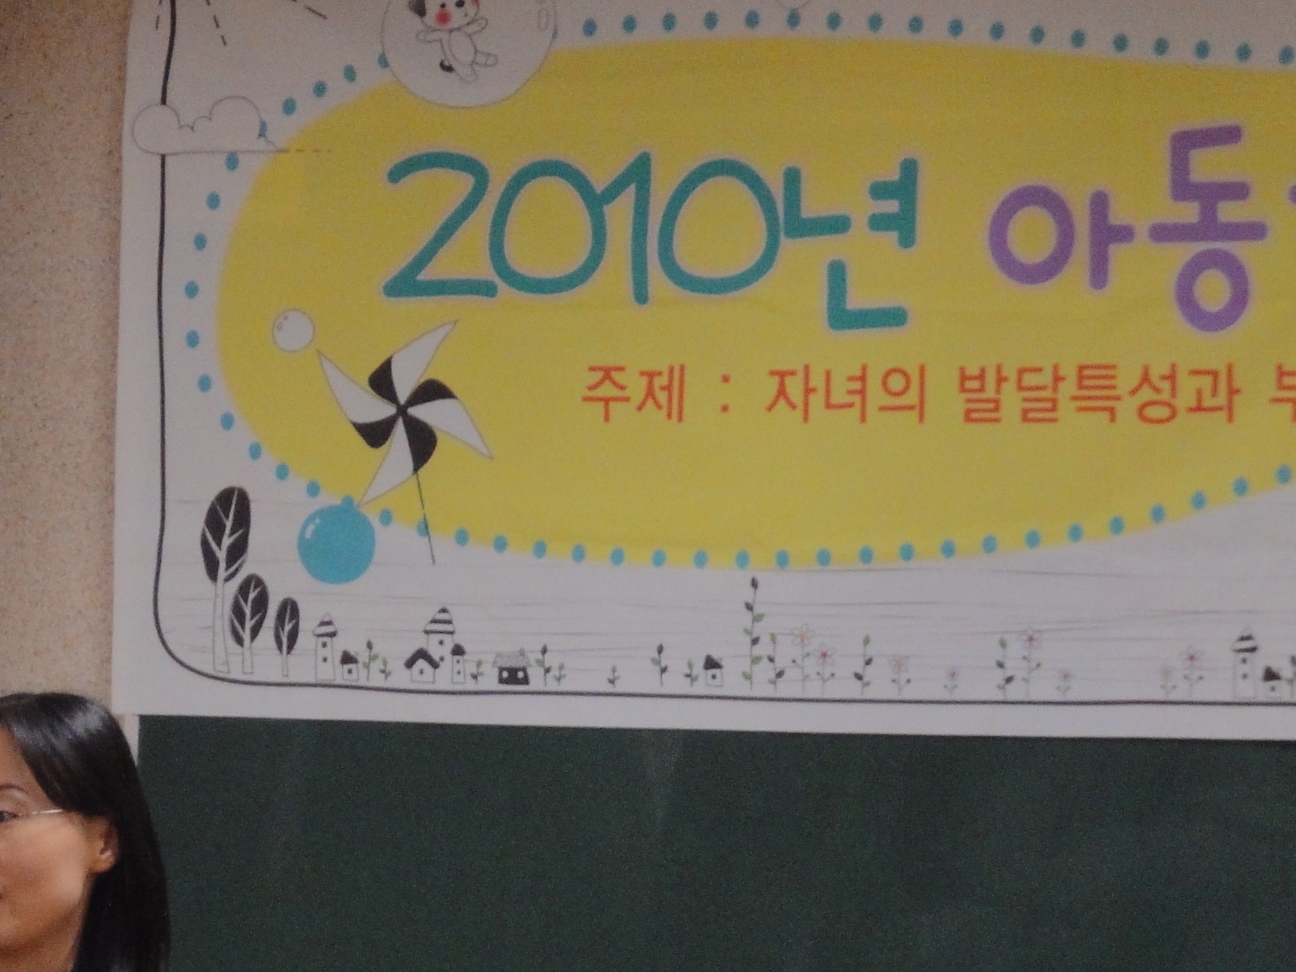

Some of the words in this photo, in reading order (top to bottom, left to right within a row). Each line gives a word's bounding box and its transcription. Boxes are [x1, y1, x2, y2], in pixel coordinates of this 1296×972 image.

[382, 149, 919, 331] 2010년
[988, 123, 1296, 334] 아동
[581, 363, 686, 424] 주제
[764, 362, 927, 424] 자녀의
[958, 361, 1242, 426] 발달특성과
